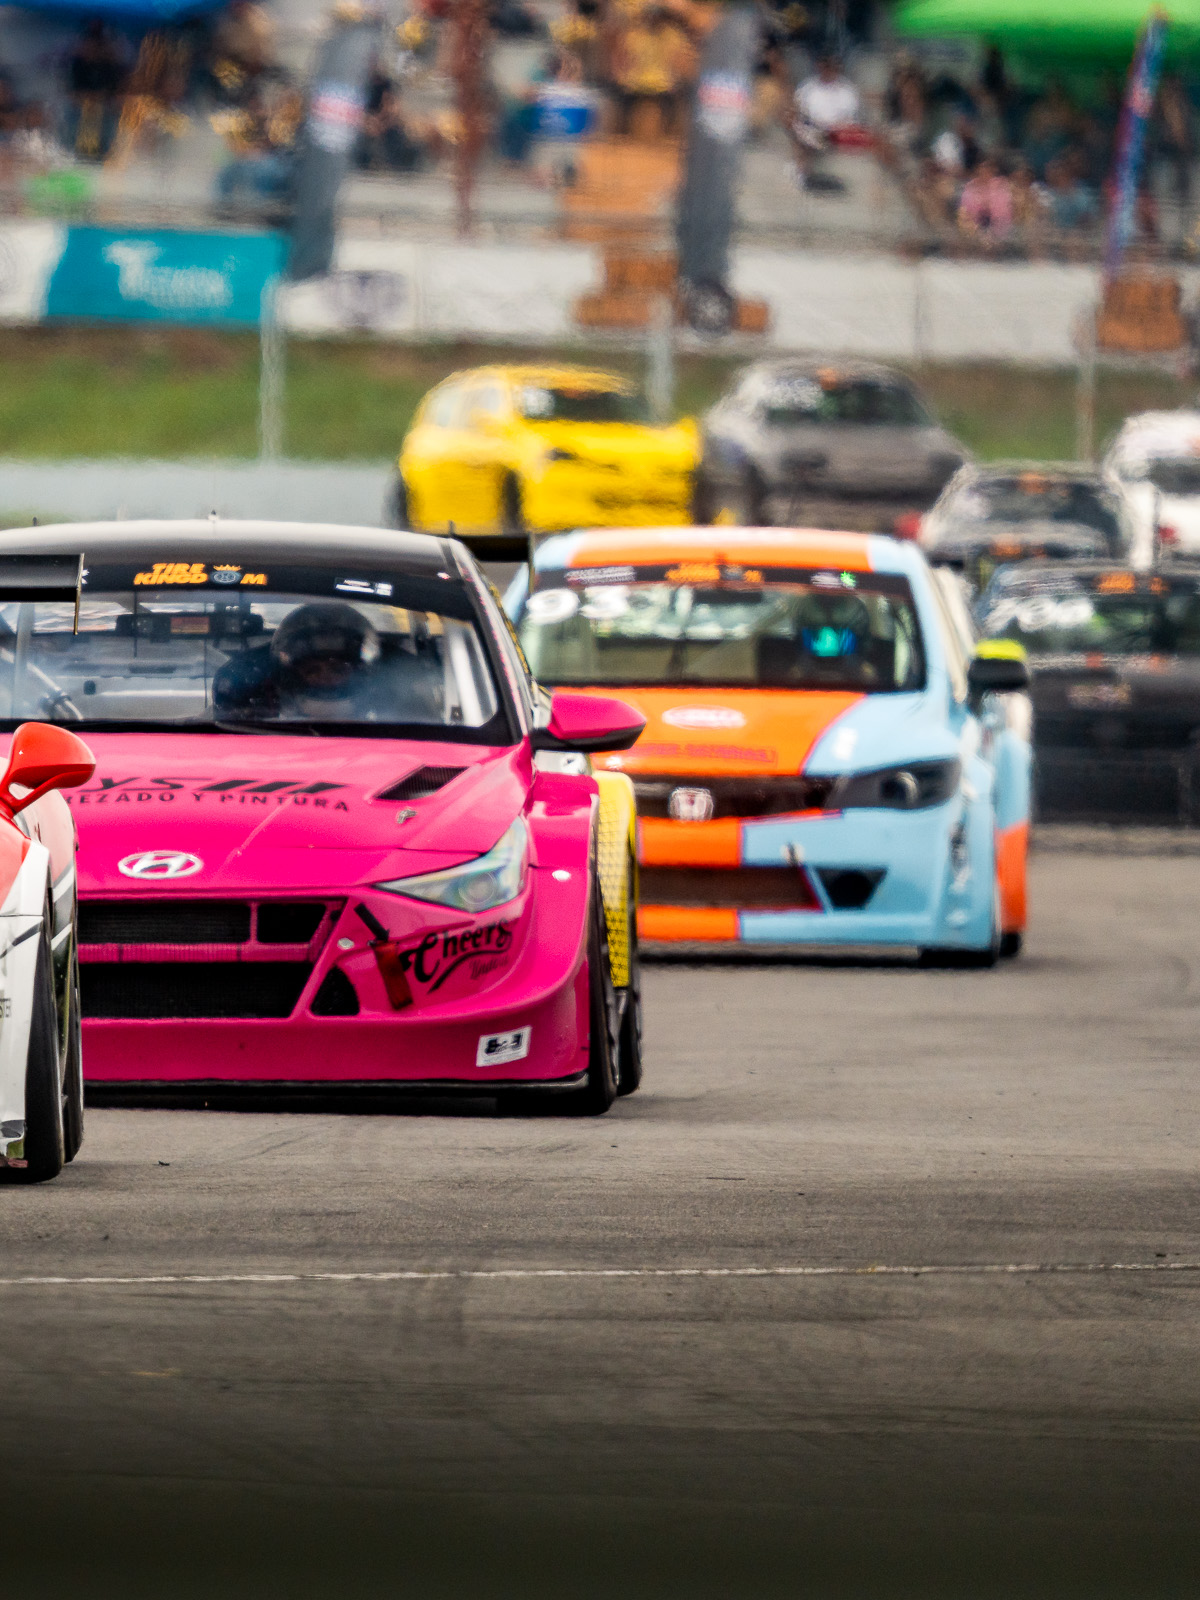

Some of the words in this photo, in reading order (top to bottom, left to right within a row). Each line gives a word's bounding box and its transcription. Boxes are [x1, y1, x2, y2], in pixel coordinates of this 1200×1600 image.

[152, 562, 206, 575] TIRE
[220, 793, 349, 812] PINTURA
[398, 918, 513, 983] Cheers
